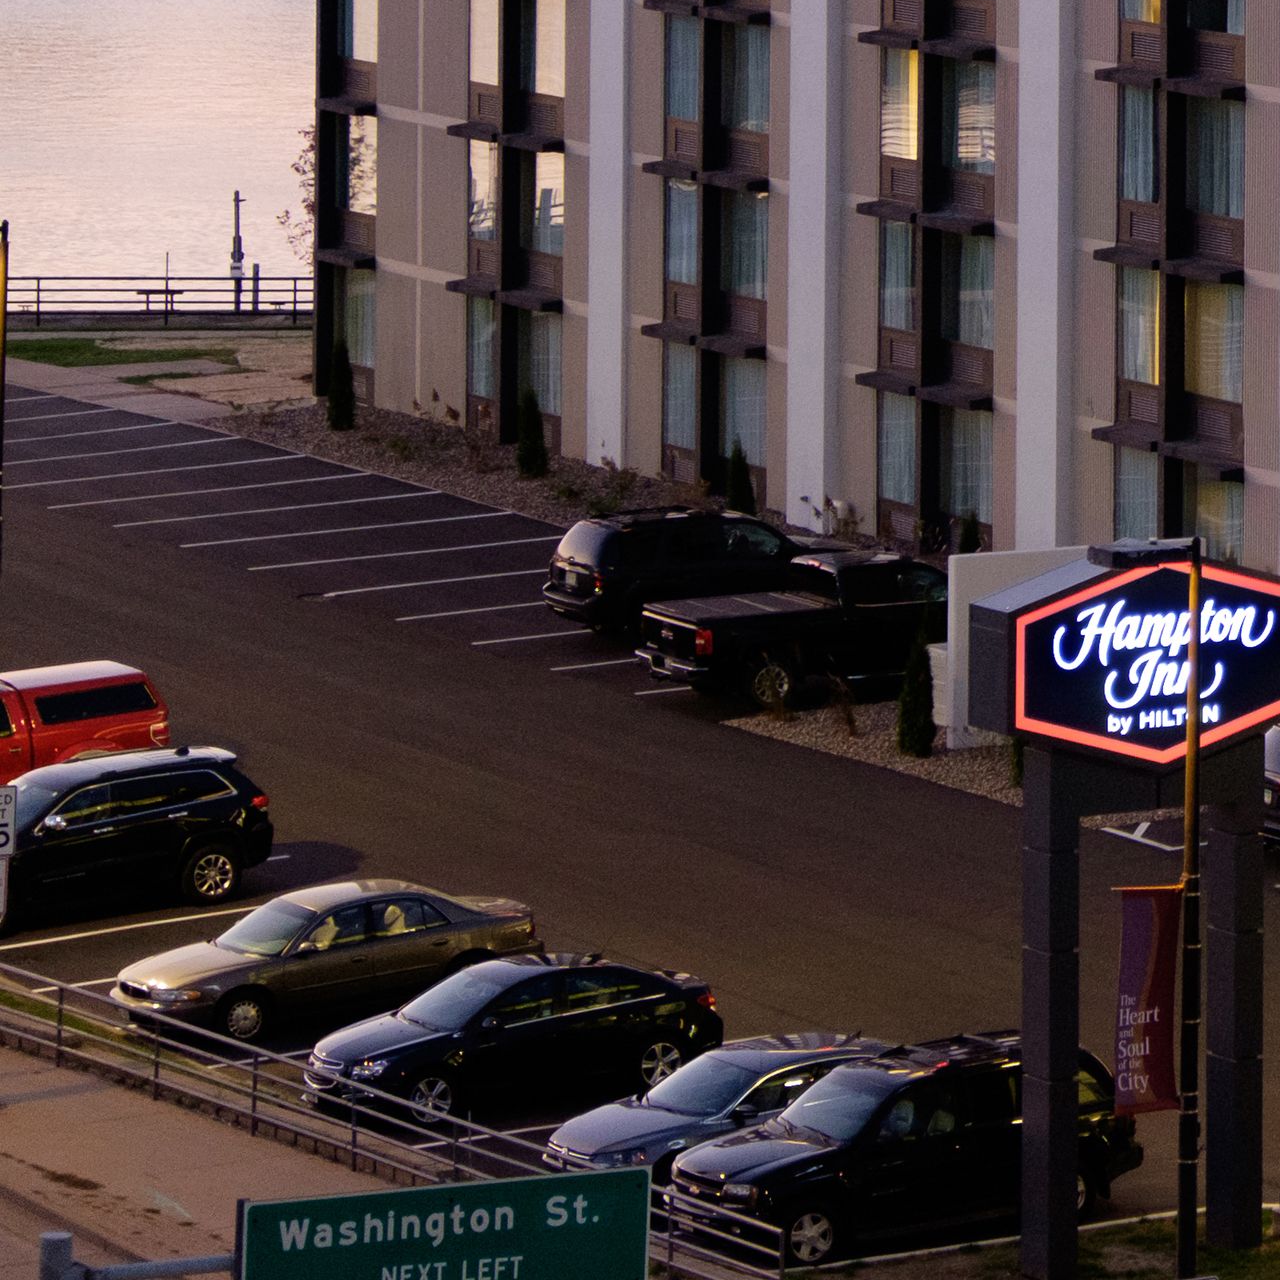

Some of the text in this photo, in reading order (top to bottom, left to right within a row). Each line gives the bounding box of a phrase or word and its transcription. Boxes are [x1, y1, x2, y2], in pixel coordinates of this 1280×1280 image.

[1107, 705, 1219, 735] by HILTN
[1120, 994, 1136, 1007] The
[1119, 1006, 1160, 1027] Heart
[1119, 1027, 1134, 1038] and
[1118, 1036, 1150, 1059] Soul
[1118, 1058, 1142, 1070] of the
[1118, 1072, 1149, 1094] City
[279, 1193, 600, 1251] Washington St.
[462, 1255, 524, 1280] LEFT
